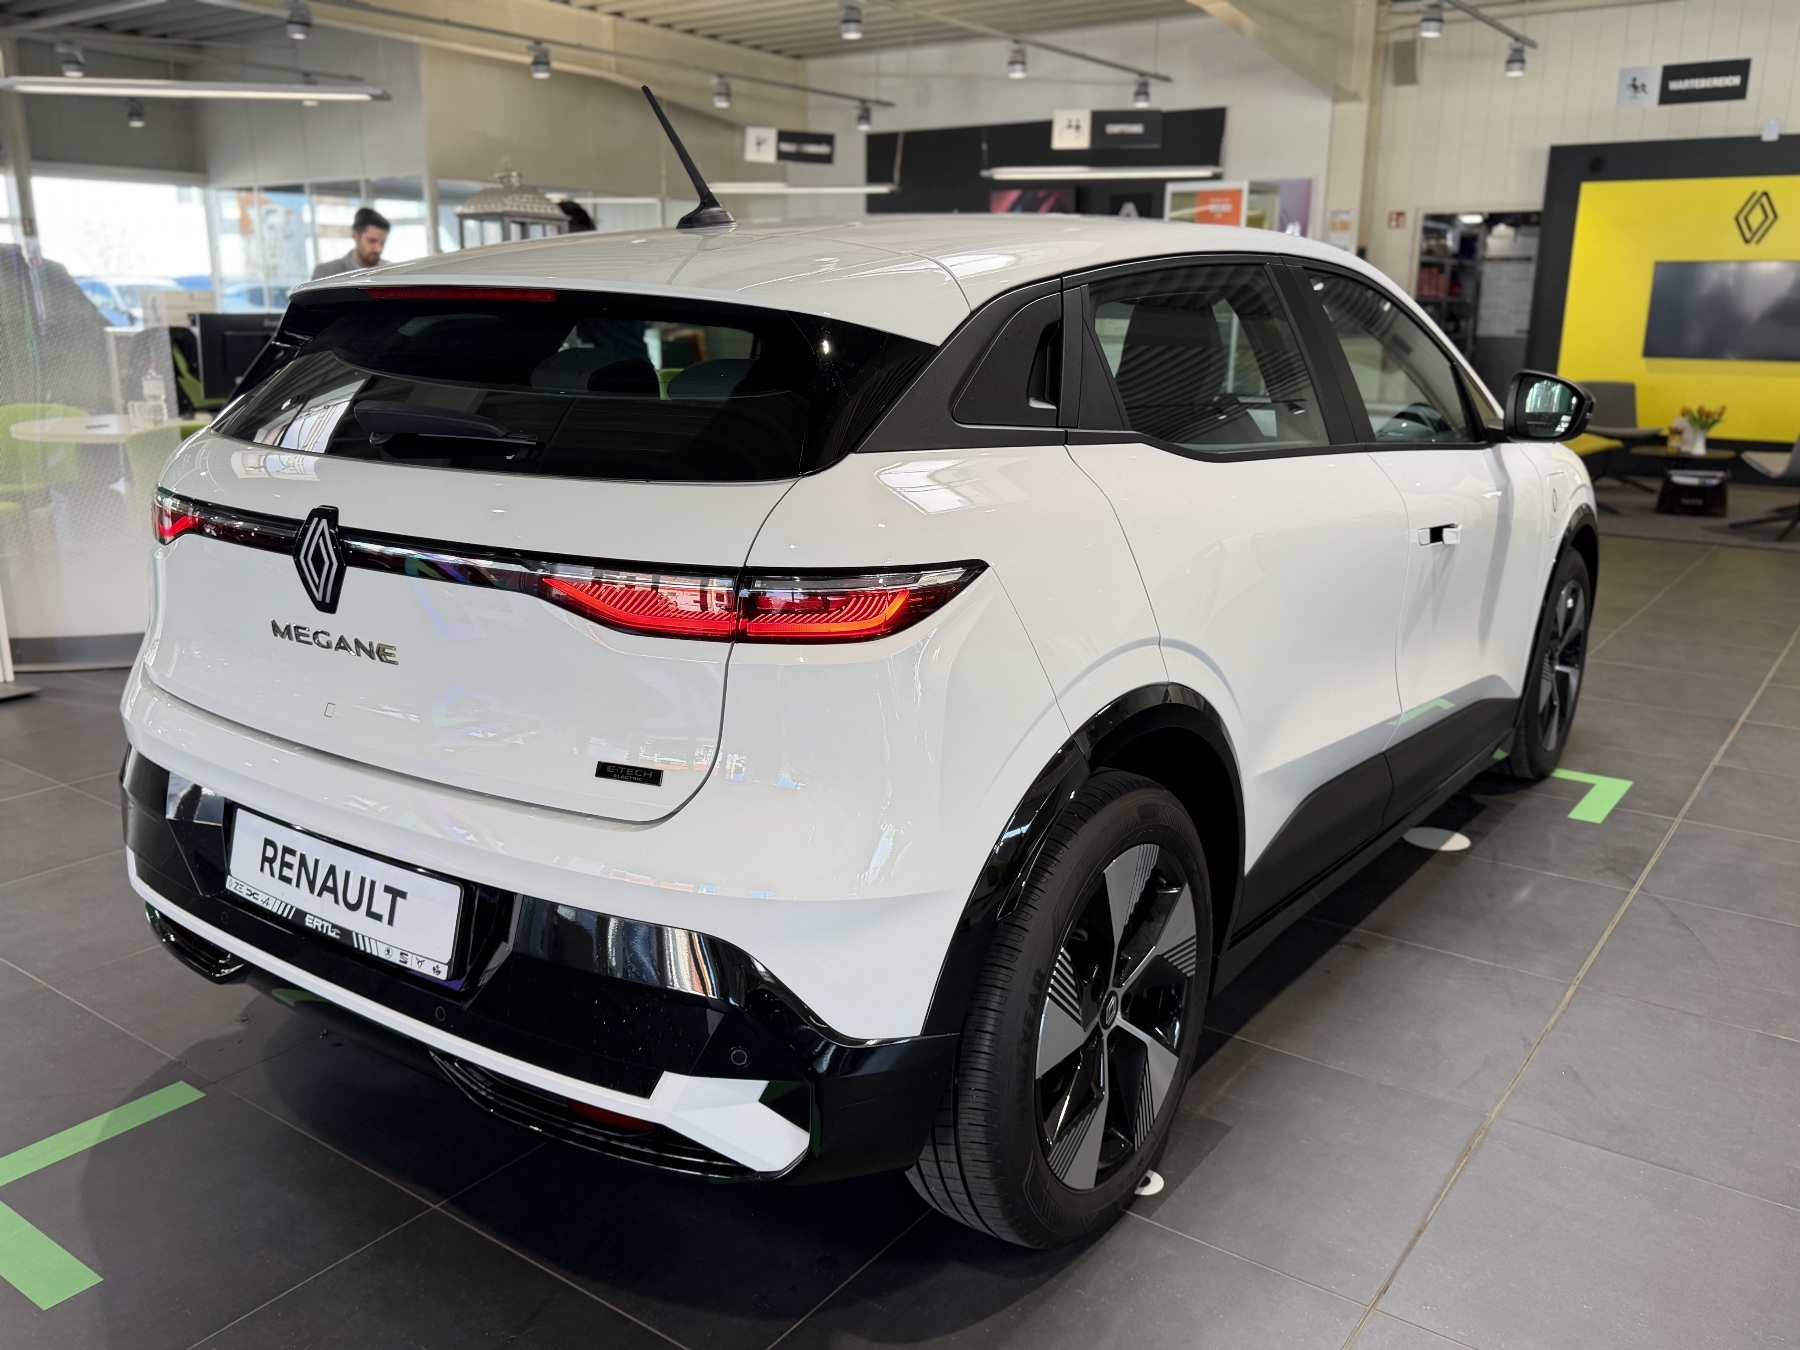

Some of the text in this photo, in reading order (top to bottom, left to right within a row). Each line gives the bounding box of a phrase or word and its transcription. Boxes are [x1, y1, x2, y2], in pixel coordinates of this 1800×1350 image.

[1668, 75, 1742, 92] WARTEBEREICH
[270, 619, 399, 666] MEGANE
[606, 765, 653, 779] E-TECH
[613, 773, 643, 782] ELECTRIC
[259, 836, 408, 928] RENAULT
